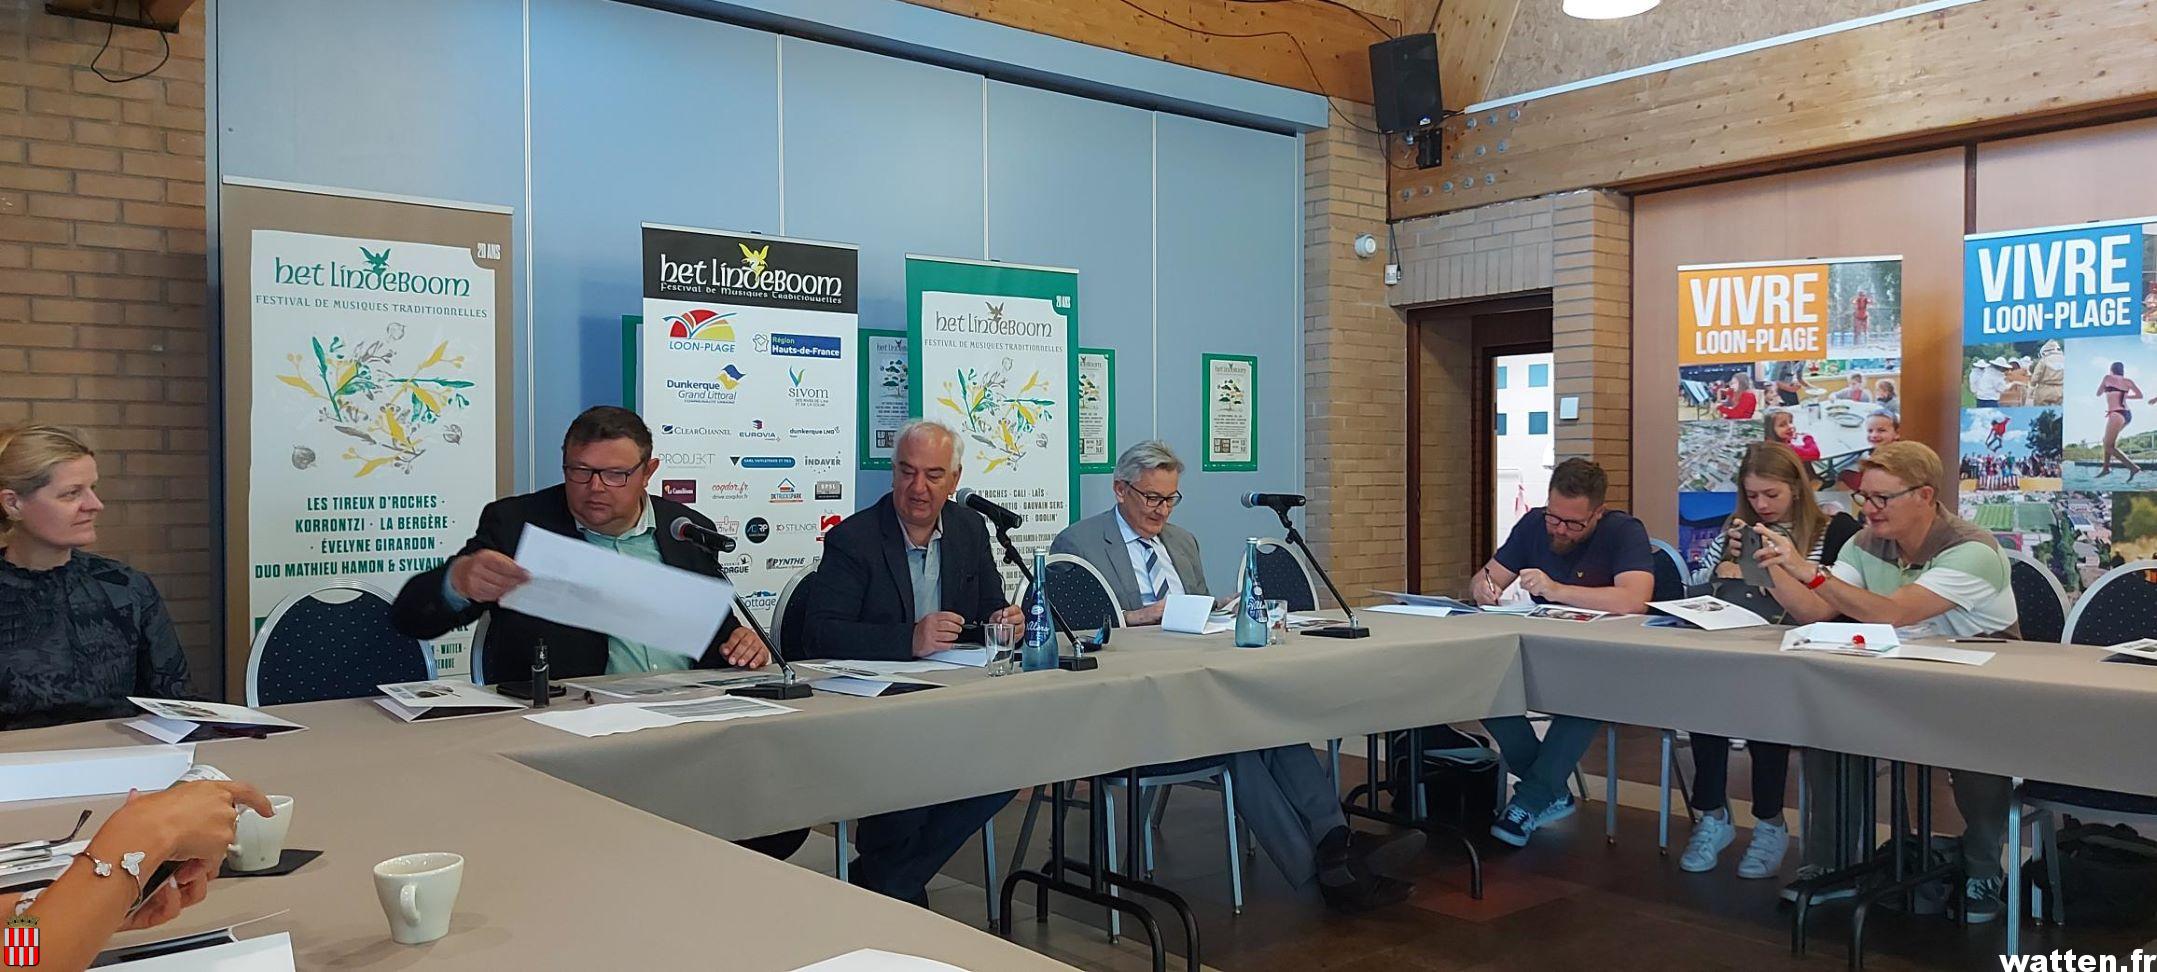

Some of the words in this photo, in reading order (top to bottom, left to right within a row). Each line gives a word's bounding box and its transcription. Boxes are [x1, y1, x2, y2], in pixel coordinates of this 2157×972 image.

[275, 256, 324, 286] het
[660, 254, 707, 285] het
[1978, 234, 2131, 302] VIVRE
[660, 282, 702, 292] Festival
[706, 286, 717, 294] de
[721, 288, 768, 298] Musiques
[256, 294, 311, 307] FESTIVAL
[315, 298, 329, 308] DE
[333, 300, 389, 312] MUSIQUES
[392, 304, 488, 318] TRADITIONNELLES
[1690, 273, 1819, 326] VIVRE
[936, 311, 965, 332] het
[1983, 297, 2131, 334] LOON-PLAGE
[669, 341, 736, 352] LOON-PLAGE
[772, 336, 795, 345] Région
[924, 338, 957, 348] FESTIVAL
[960, 340, 968, 348] DE
[970, 341, 1003, 350] MUSIQUES
[1005, 344, 1063, 352] TRADITIONNELLES
[1696, 326, 1819, 354] LOON-PLAGE
[772, 345, 840, 356] Hauts-de-France
[666, 380, 720, 391] Dunkerque
[678, 390, 706, 400] Grand
[708, 391, 737, 400] Littoral
[804, 458, 840, 466] INDAVER
[307, 497, 328, 510] LES
[333, 496, 375, 510] TIREUX
[379, 496, 437, 509] D'ROCHES
[1013, 490, 1026, 498] CALI
[295, 518, 365, 533] KORRONTZI
[380, 517, 393, 530] LA
[398, 514, 448, 530] BERGÈRE
[321, 538, 371, 554] ÉVELYNE
[375, 536, 435, 552] GIRARDON
[255, 564, 280, 579] DUO
[285, 560, 338, 577] MATHIEU
[342, 559, 384, 574] HAMON
[388, 558, 396, 572] &
